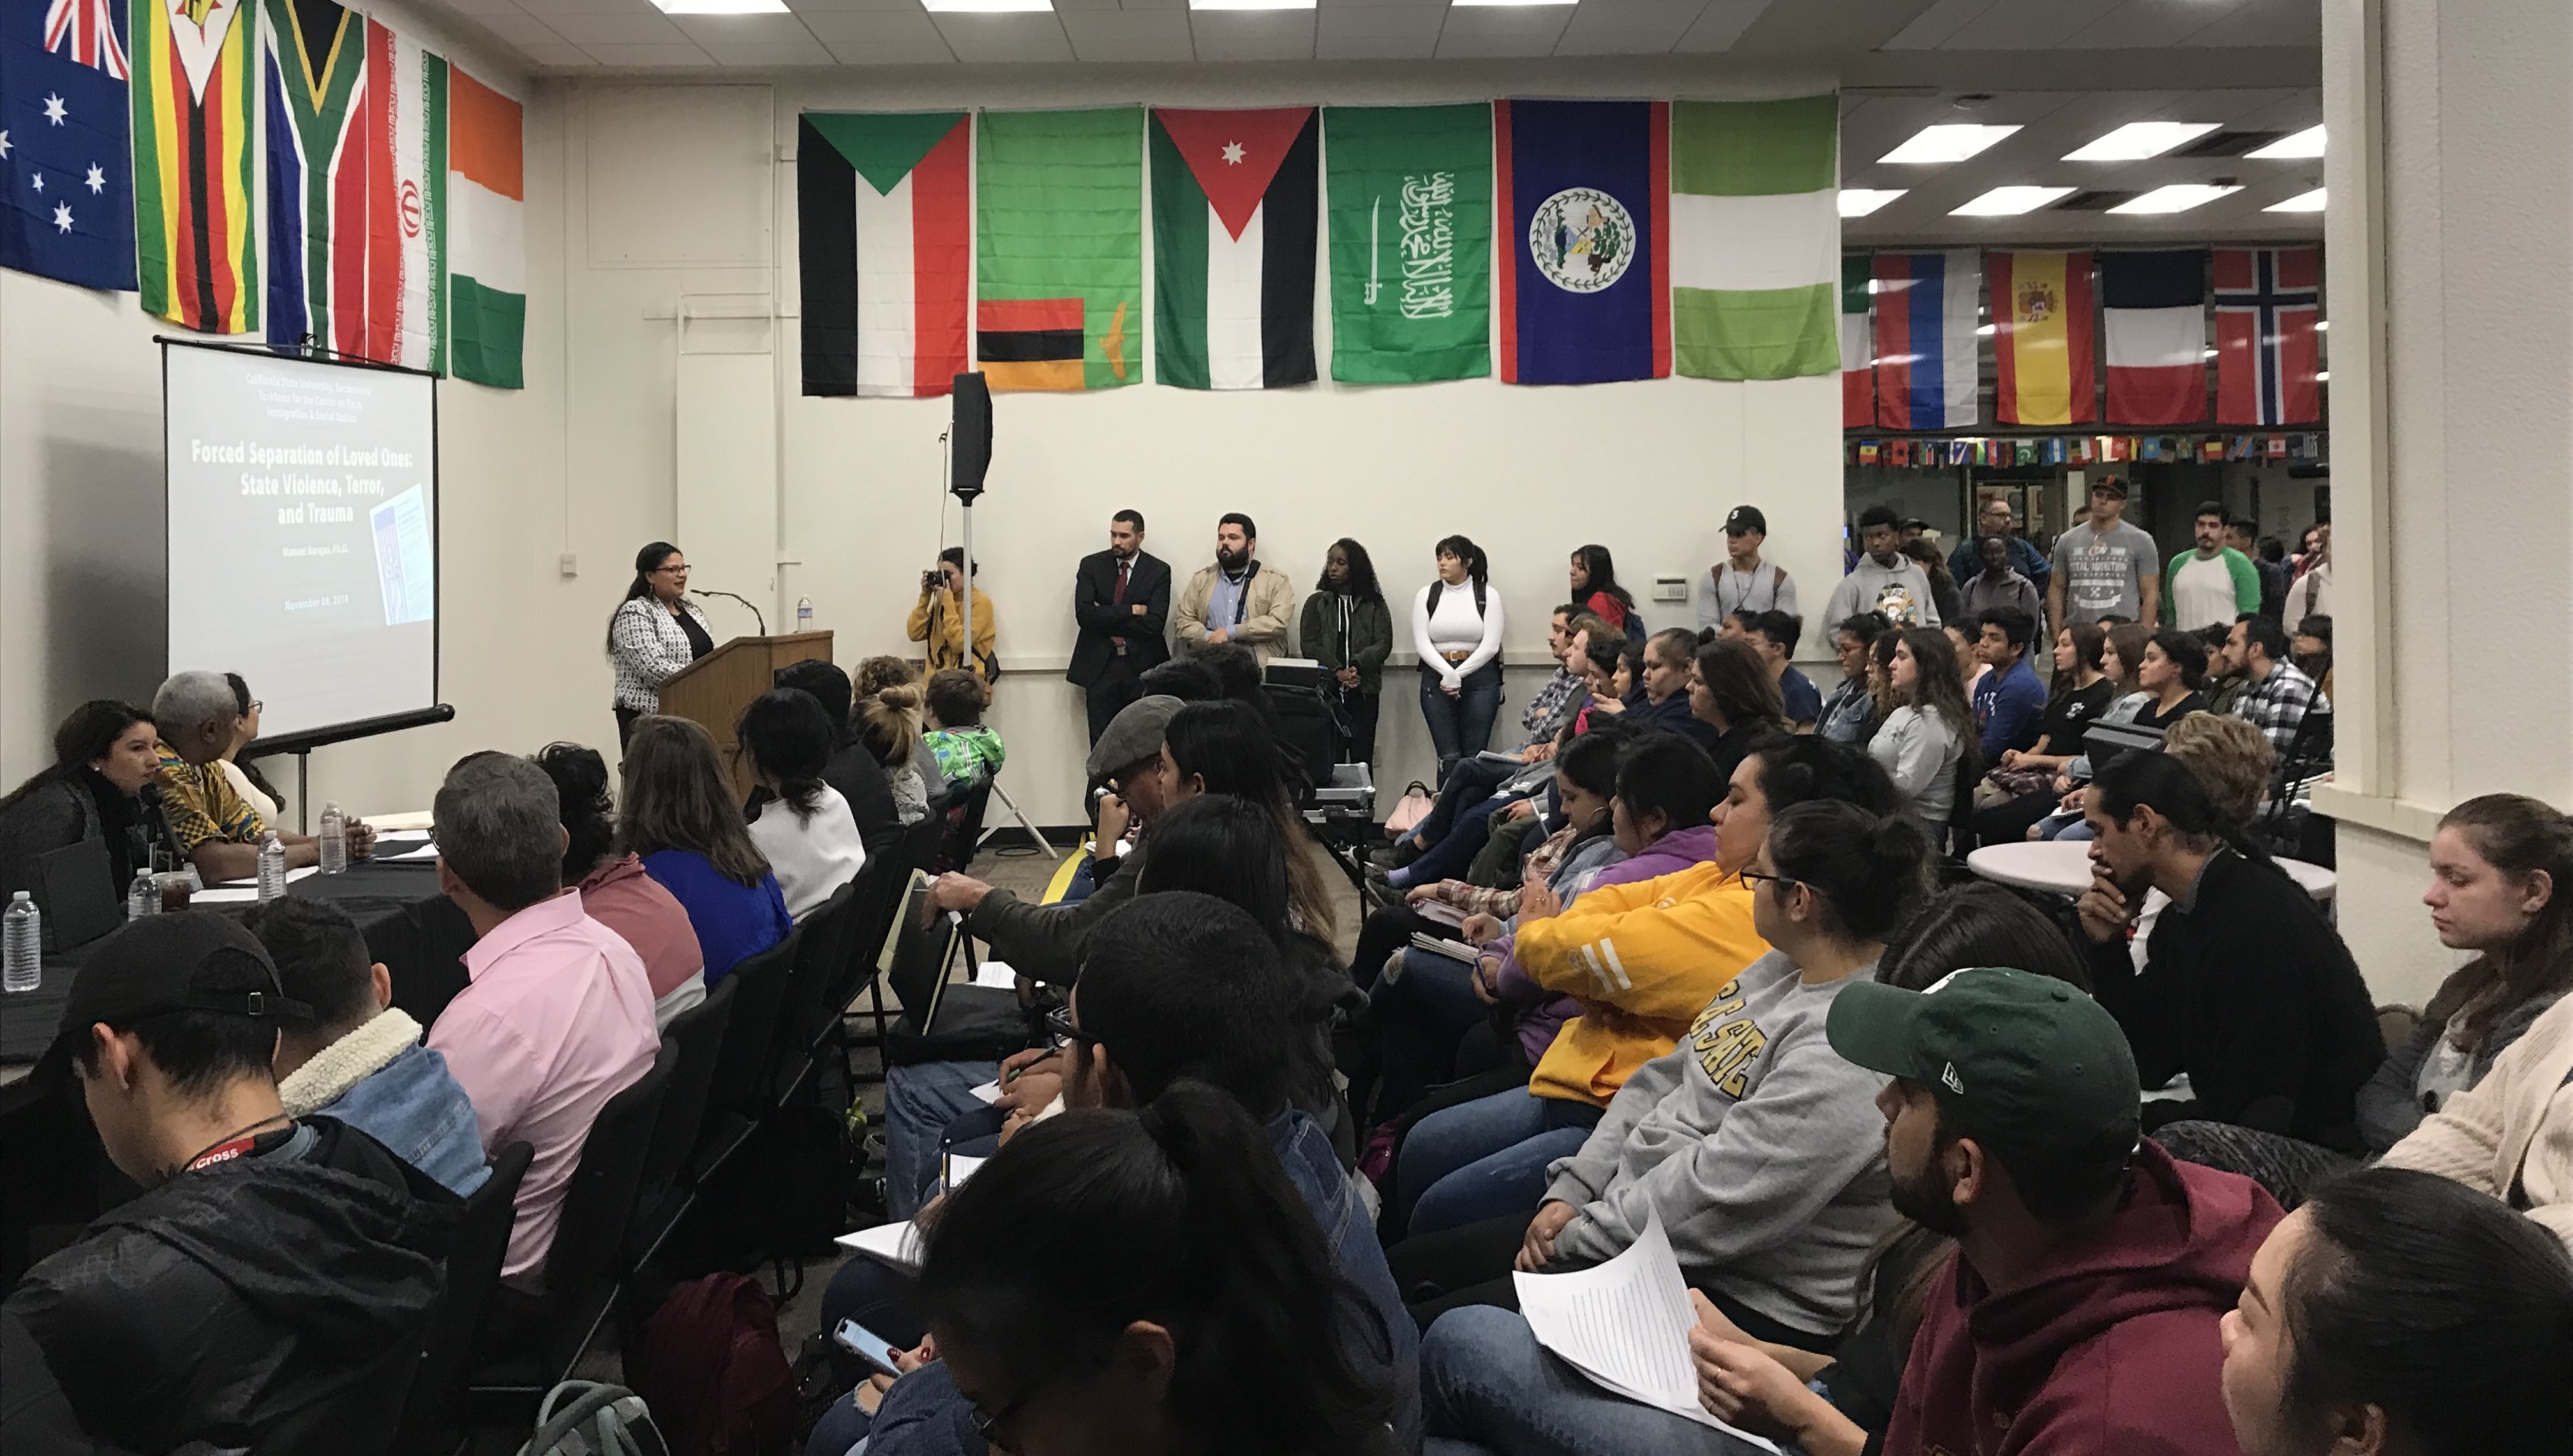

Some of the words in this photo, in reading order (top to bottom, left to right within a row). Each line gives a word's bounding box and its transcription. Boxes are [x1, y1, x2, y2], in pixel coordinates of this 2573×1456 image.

[246, 373, 280, 386] California
[281, 376, 298, 388] State
[299, 378, 334, 394] University,
[336, 382, 372, 396] Sacramento
[258, 390, 291, 403] Taskforce
[292, 392, 302, 404] for
[303, 394, 314, 405] the
[315, 396, 336, 407] Center
[337, 399, 346, 407] on
[266, 406, 308, 421] Immigration
[309, 410, 314, 420] &
[315, 410, 335, 421] Social
[336, 412, 357, 423] Justice
[191, 439, 244, 463] Forced
[249, 442, 324, 469] Separation
[326, 445, 340, 466] of
[343, 446, 378, 466] Loved
[381, 447, 413, 468] Ones:
[241, 472, 279, 495] State
[282, 473, 342, 498] Violence,
[345, 474, 385, 497] Terror,
[278, 502, 303, 524] and
[307, 502, 354, 523] Trauma
[283, 546, 307, 556] Manuel
[332, 542, 349, 553] Ph.D.
[285, 597, 320, 611] November
[332, 594, 348, 605] 2018
[196, 1148, 239, 1170] Cross
